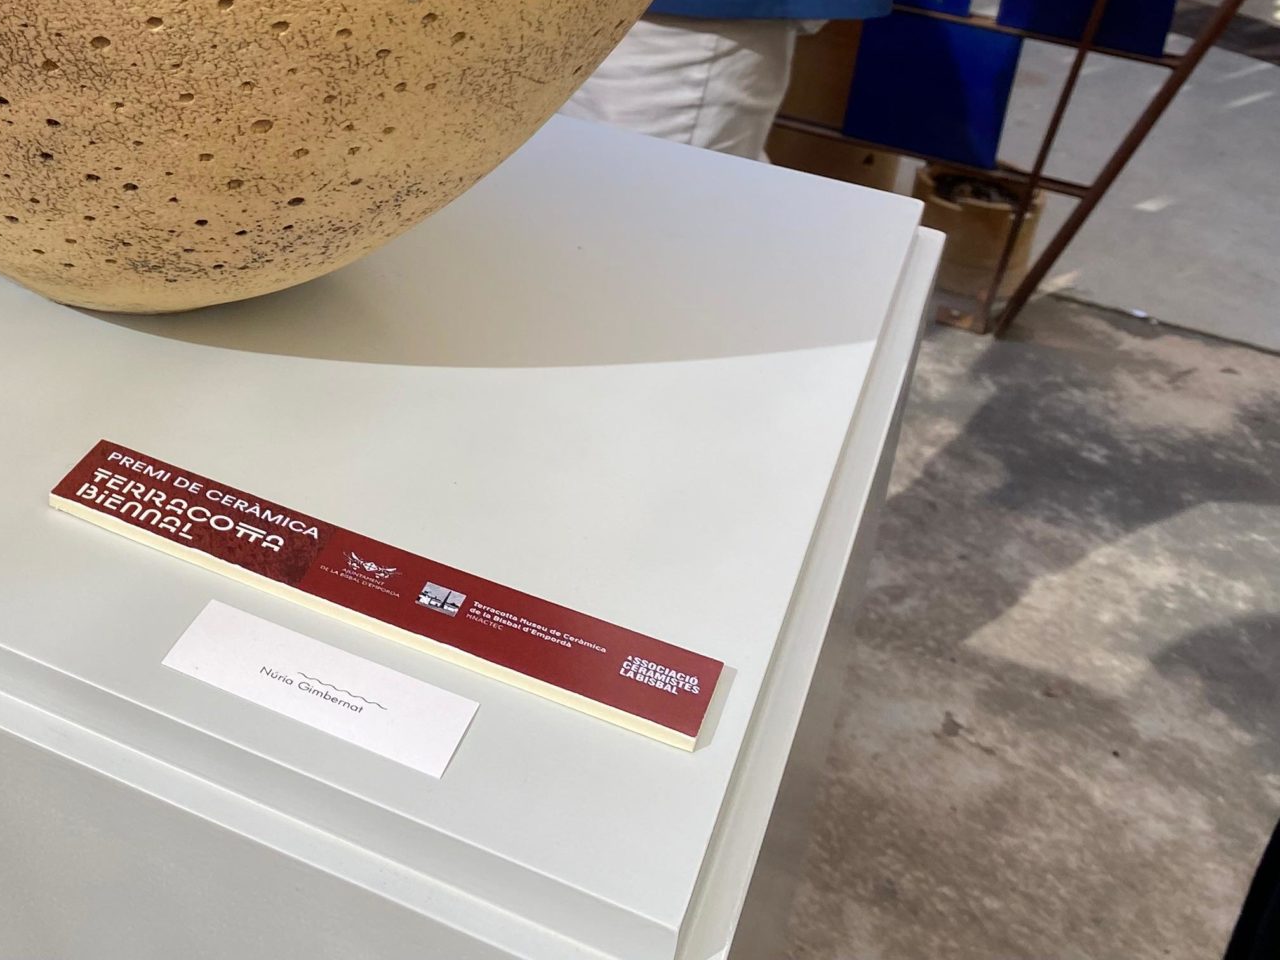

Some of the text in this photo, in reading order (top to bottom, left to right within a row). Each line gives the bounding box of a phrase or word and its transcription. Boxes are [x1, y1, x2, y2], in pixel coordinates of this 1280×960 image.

[93, 467, 286, 552] TERRACOTTA
[106, 451, 321, 539] PREMI DE CERÀMICA
[465, 613, 505, 632] MNACTEC
[469, 607, 482, 616] de
[482, 610, 492, 620] la
[492, 614, 522, 631] Bisbal
[472, 600, 607, 654] Terracotta Museu de Ceràmica
[619, 667, 679, 695] LA BISBAL
[622, 661, 701, 695] CERAMISTES
[626, 655, 699, 685] ASSOCIACIÓ
[259, 665, 365, 714] Núria Gimbernat
